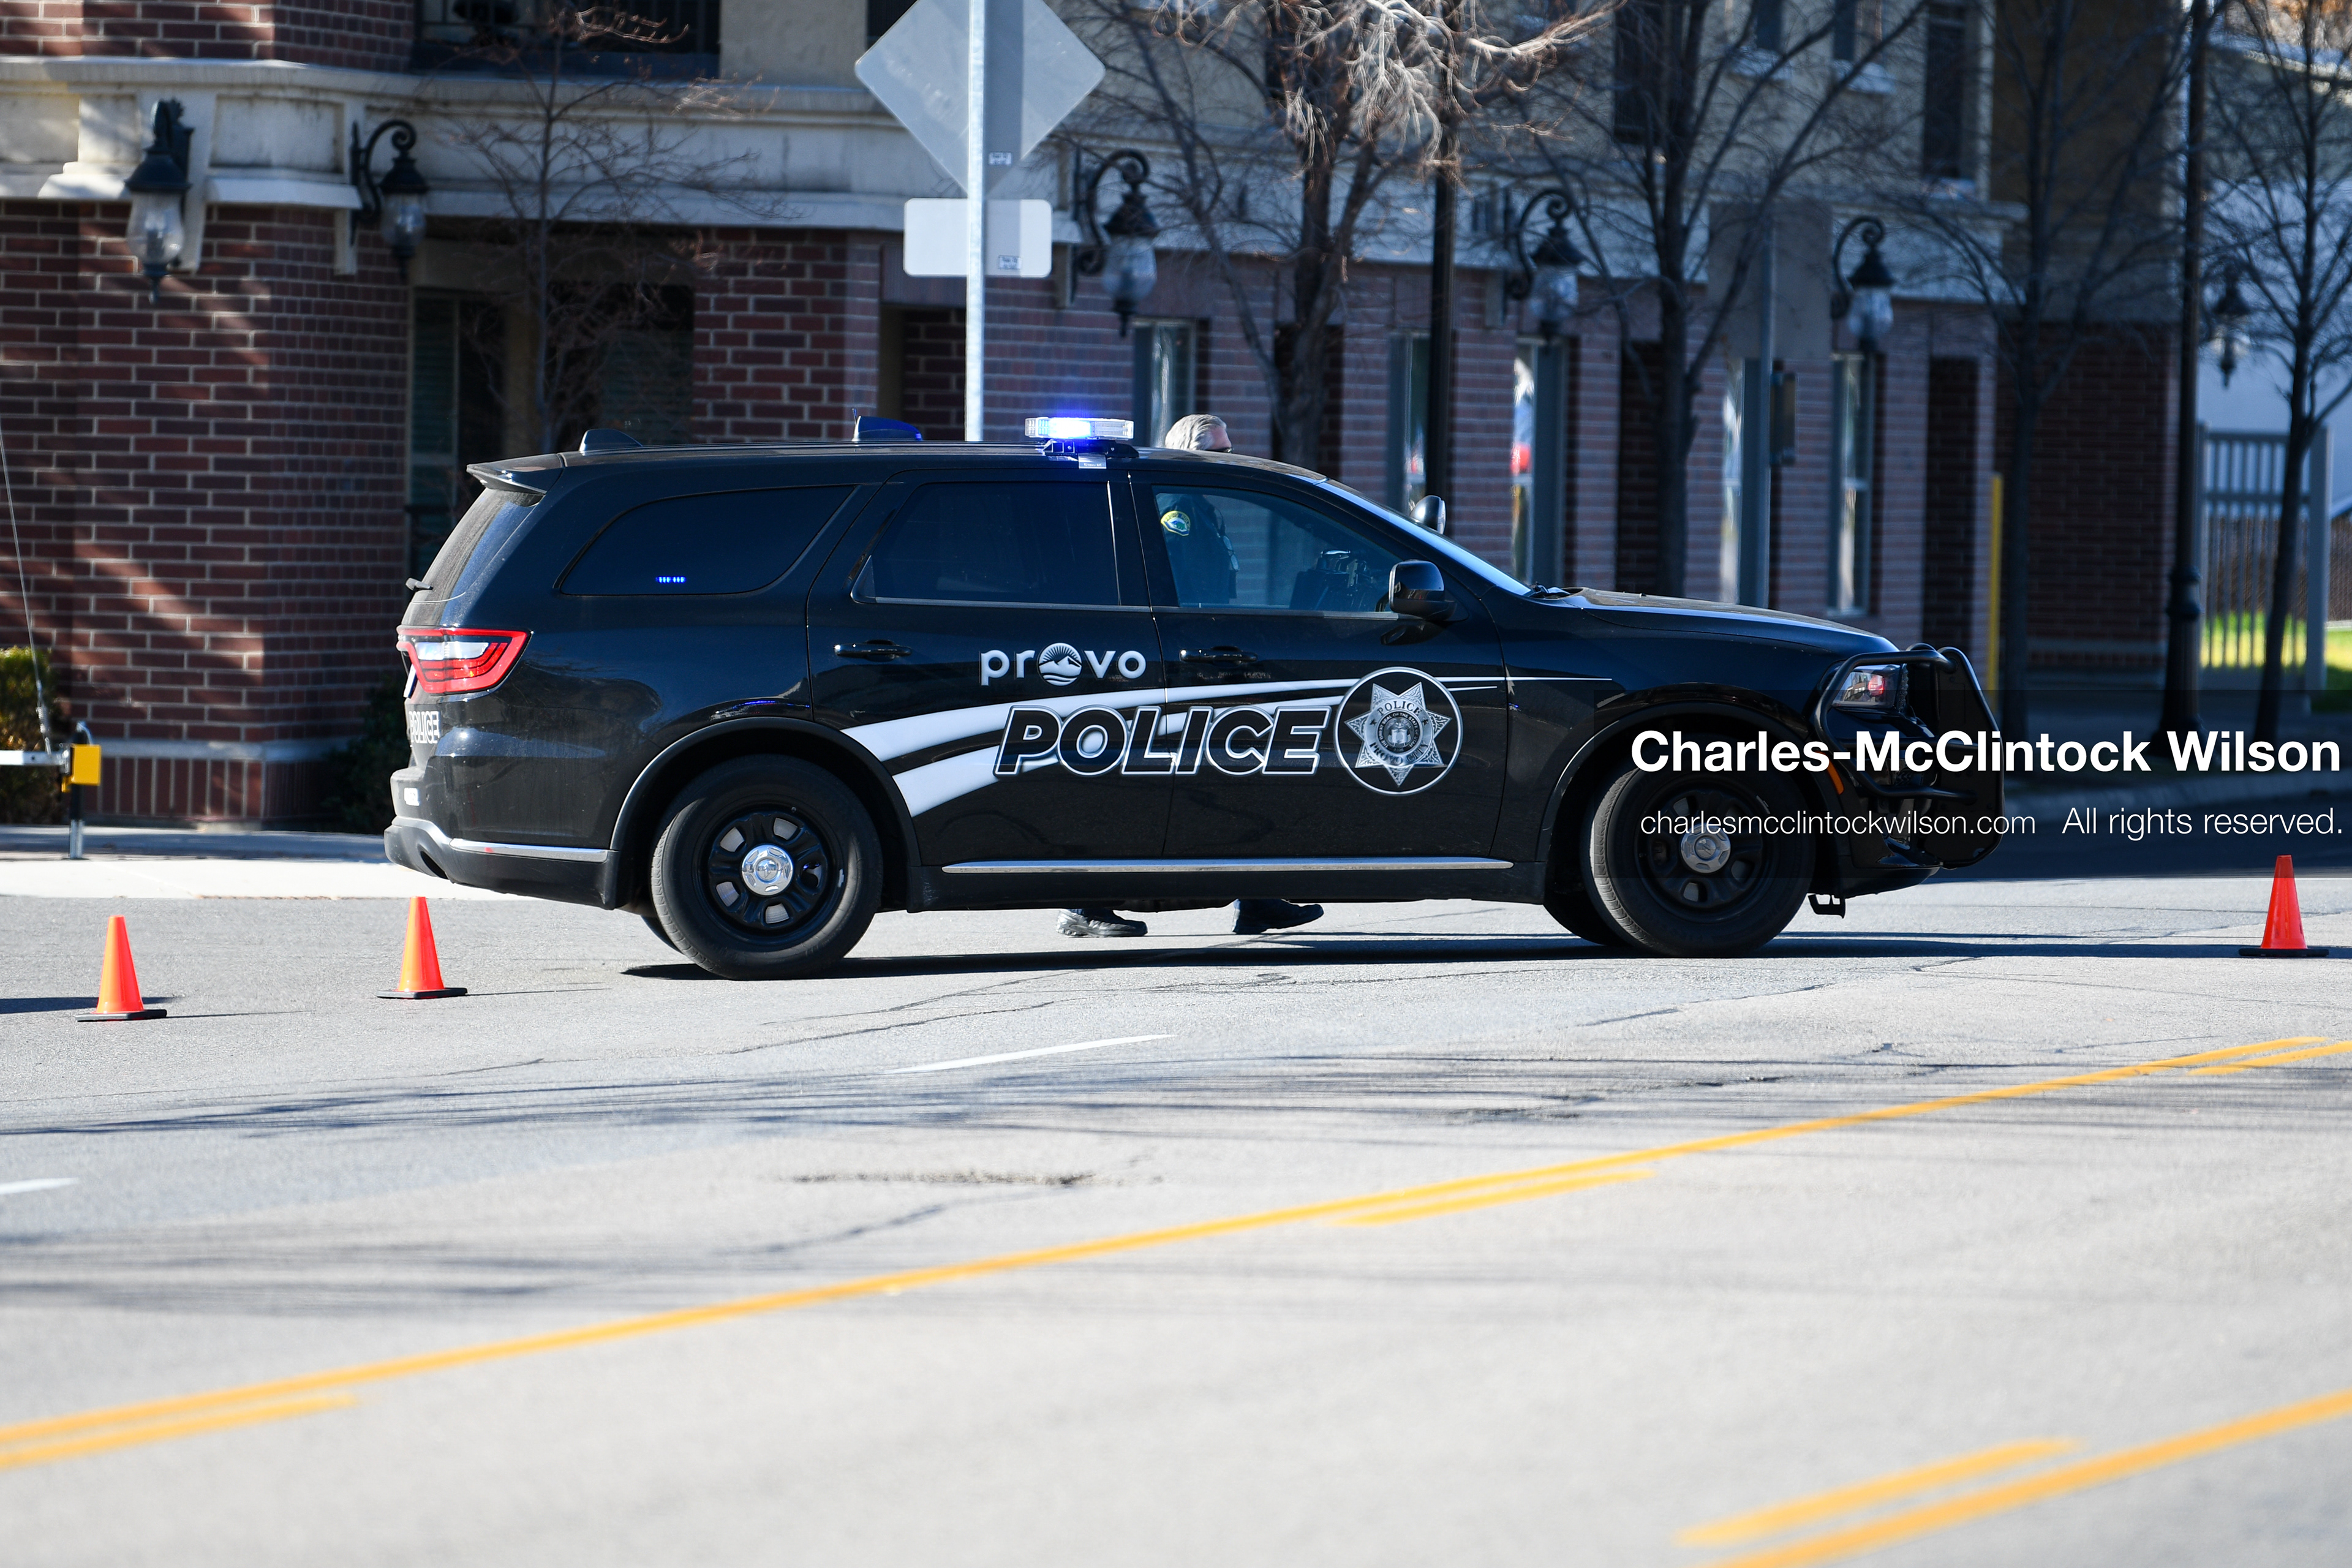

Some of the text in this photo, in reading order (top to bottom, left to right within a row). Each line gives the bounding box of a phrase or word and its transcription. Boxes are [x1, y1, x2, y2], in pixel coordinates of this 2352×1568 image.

[1377, 700, 1422, 716] POLICE
[409, 710, 440, 744] POLICE
[1408, 716, 1418, 729] STATE
[993, 705, 1332, 775] POLICE
[1370, 742, 1429, 764] PROVO CITY
